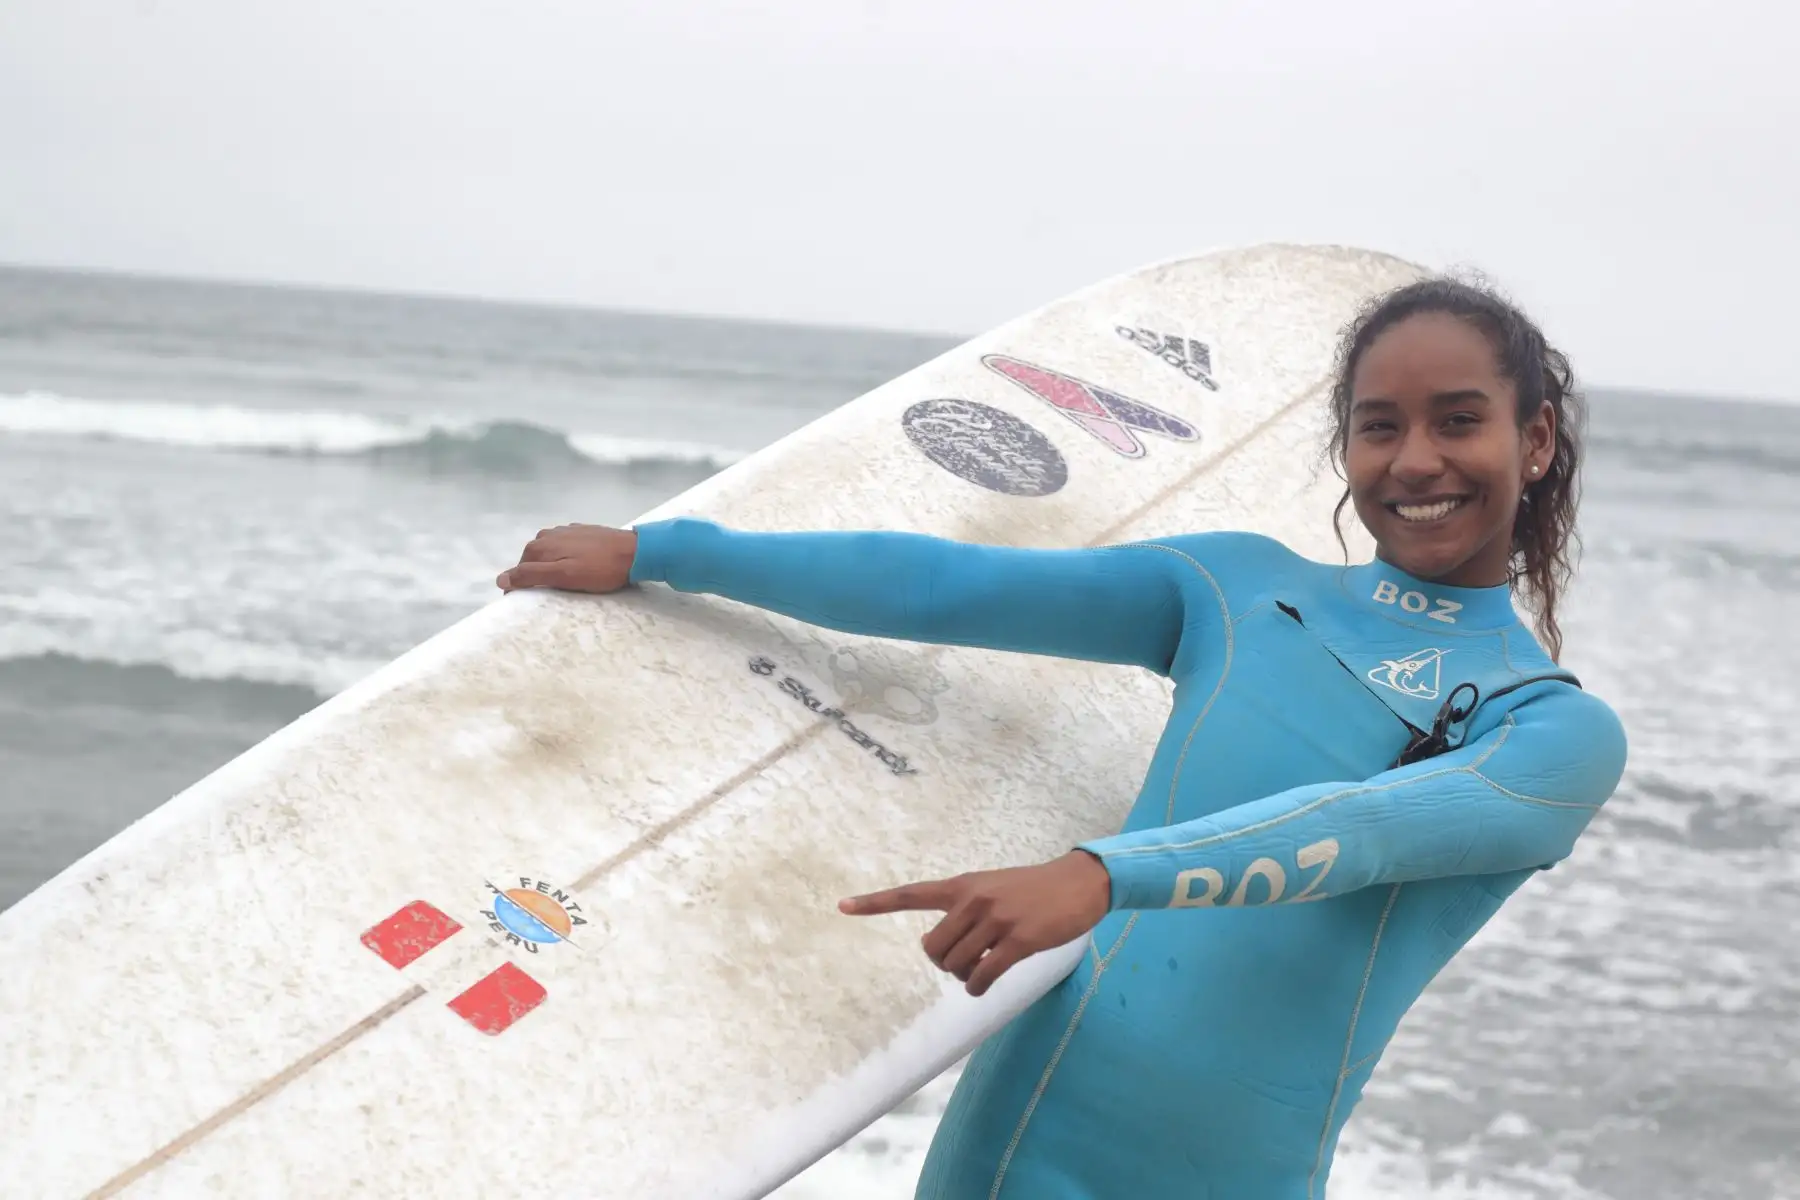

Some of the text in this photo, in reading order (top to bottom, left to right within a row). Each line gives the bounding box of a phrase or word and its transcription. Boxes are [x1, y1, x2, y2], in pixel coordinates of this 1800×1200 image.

[1114, 325, 1219, 392] adidas
[1372, 580, 1463, 624] BOZ
[1167, 838, 1340, 908] BOZ
[519, 877, 588, 926] FENTA
[479, 909, 540, 954] PERU
